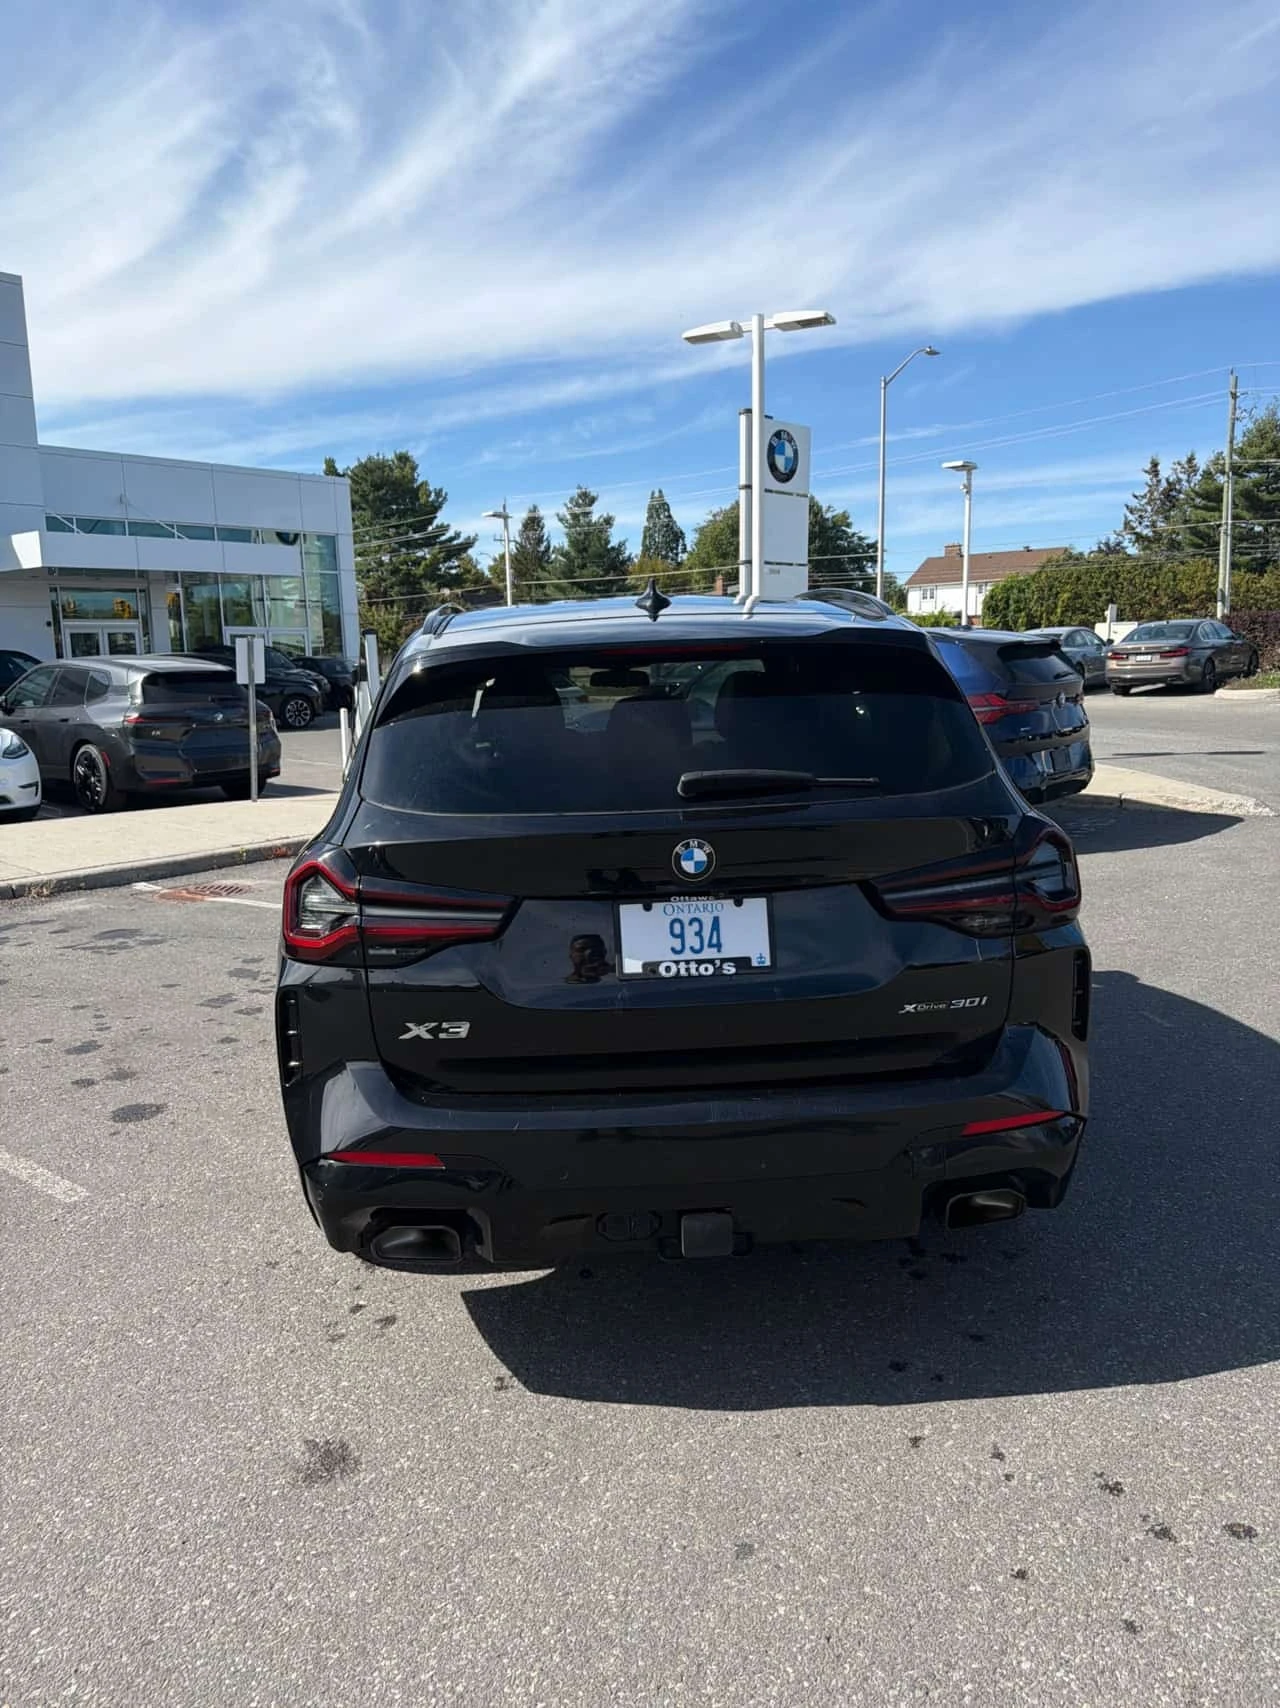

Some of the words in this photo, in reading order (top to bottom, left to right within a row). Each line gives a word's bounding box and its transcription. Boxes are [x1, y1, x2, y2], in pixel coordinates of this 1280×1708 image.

[663, 902, 724, 916] ONTARIO
[669, 916, 722, 955] 934
[658, 960, 737, 977] Otto's
[398, 1021, 470, 1040] X3
